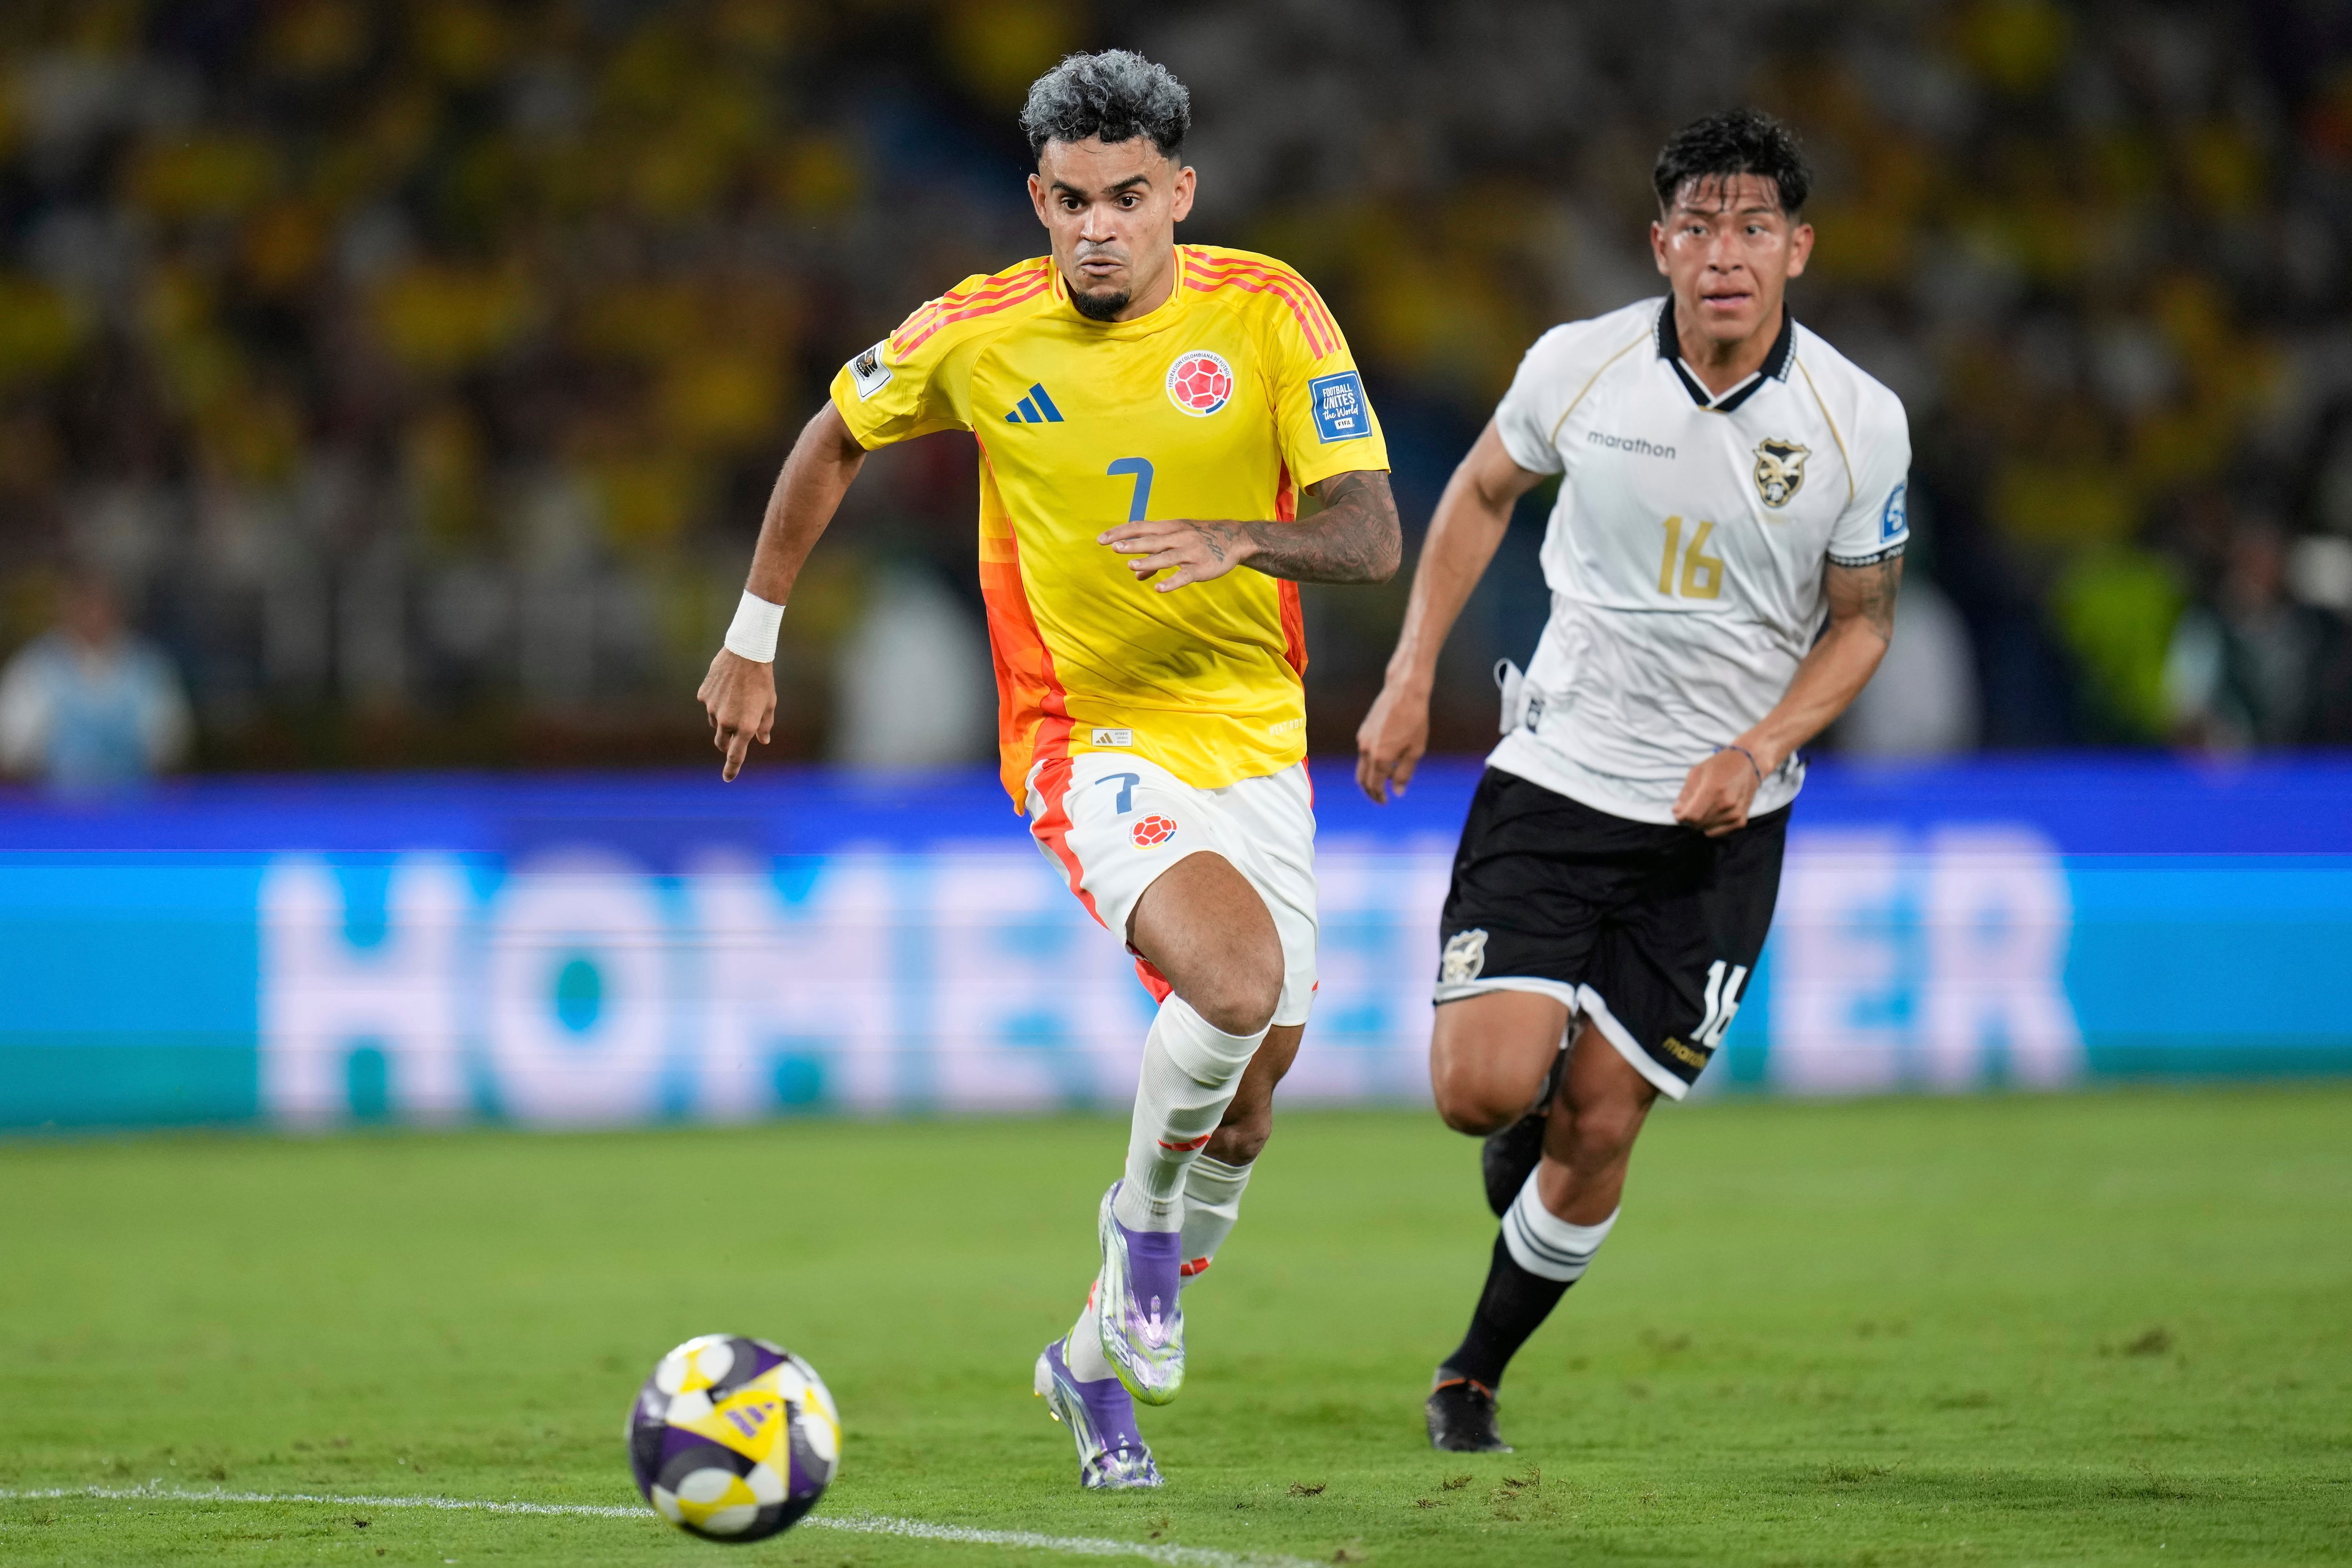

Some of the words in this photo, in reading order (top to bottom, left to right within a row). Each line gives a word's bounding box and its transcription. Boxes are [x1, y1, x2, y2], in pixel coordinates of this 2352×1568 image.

[1182, 353, 1213, 362] COLOMBIANA
[1218, 360, 1230, 377] FUTBOL
[1322, 383, 1352, 398] FOOTBALL
[1323, 392, 1355, 410] UNITES
[1322, 409, 1336, 420] the
[1335, 404, 1359, 418] World
[1587, 431, 1676, 460] marathon
[1107, 457, 1154, 539] 7
[1658, 515, 1724, 600] 16
[1269, 721, 1287, 736] HEAT
[1289, 717, 1303, 730] RDY
[1095, 772, 1140, 815] 7
[1689, 959, 1747, 1050] 16
